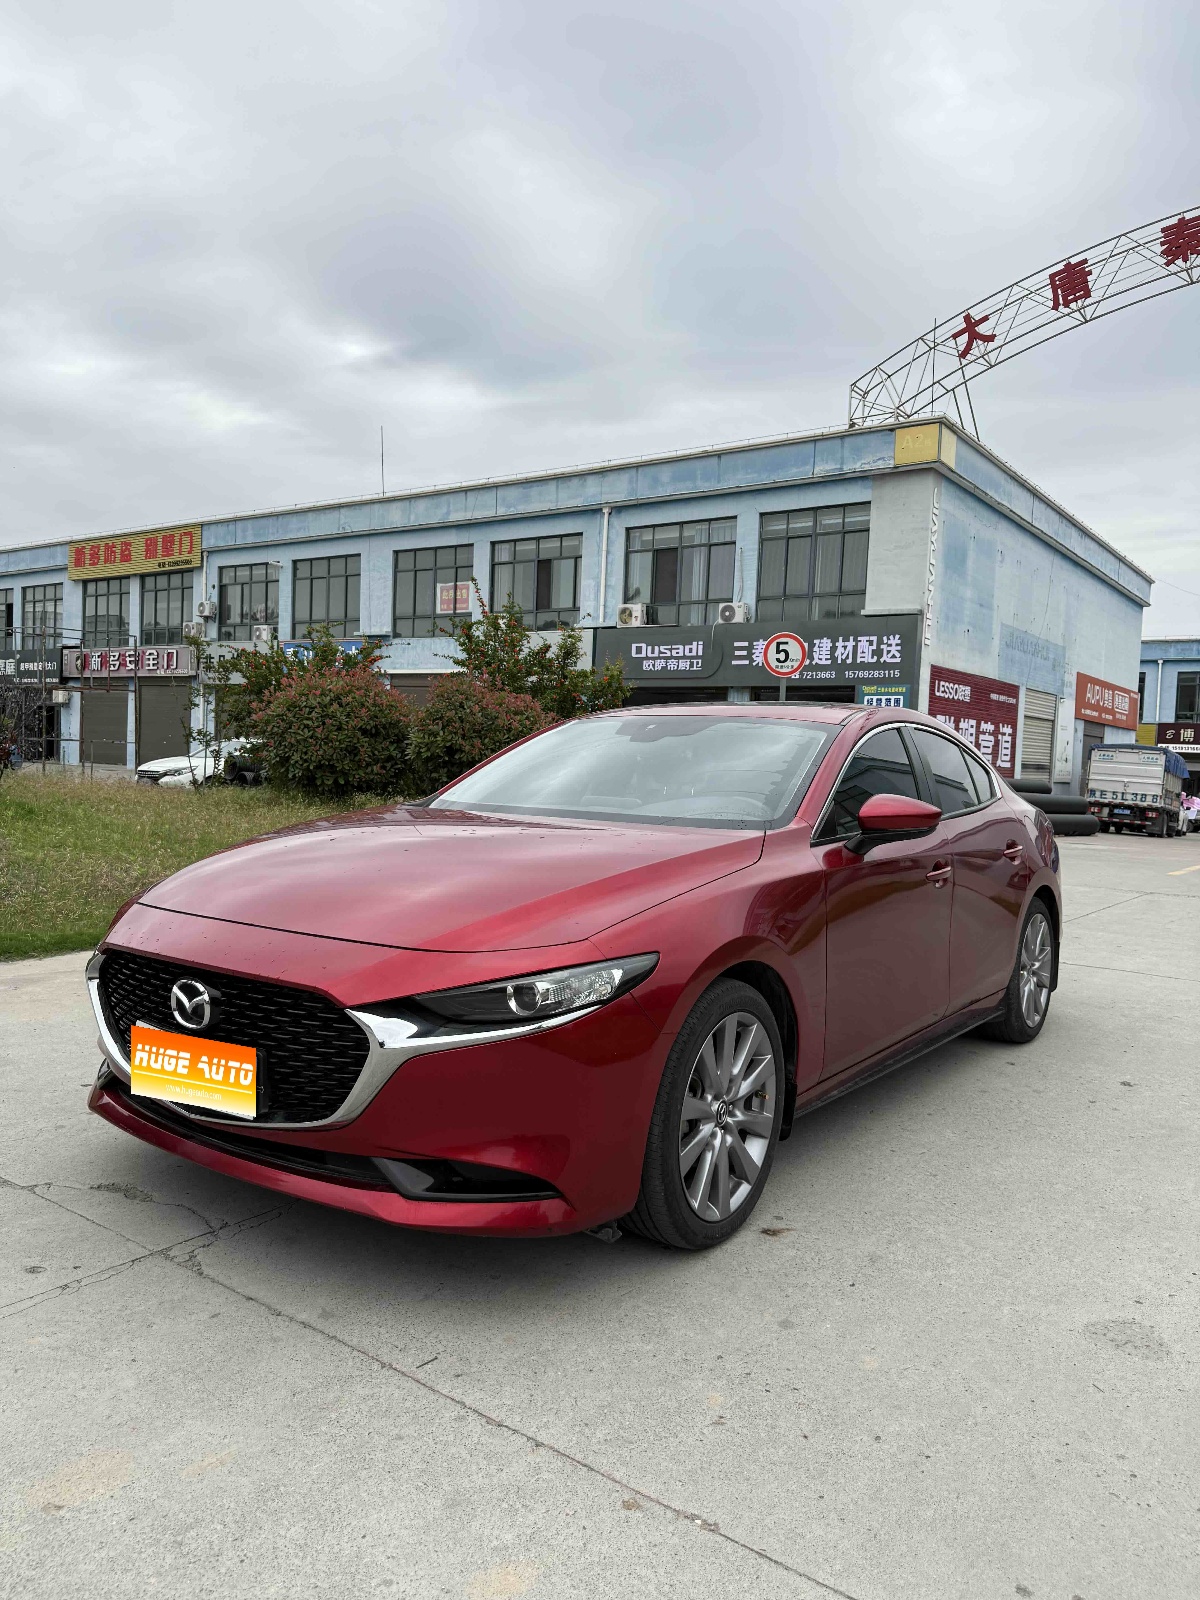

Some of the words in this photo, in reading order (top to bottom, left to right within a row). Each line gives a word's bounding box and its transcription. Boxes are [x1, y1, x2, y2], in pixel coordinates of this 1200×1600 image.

[144, 531, 194, 560] 别墅门
[631, 641, 704, 658] Ousadi
[775, 641, 790, 664] 5
[642, 659, 702, 671] 欧萨帝厨卫
[802, 671, 836, 679] 7213663
[844, 670, 900, 679] 15769283115
